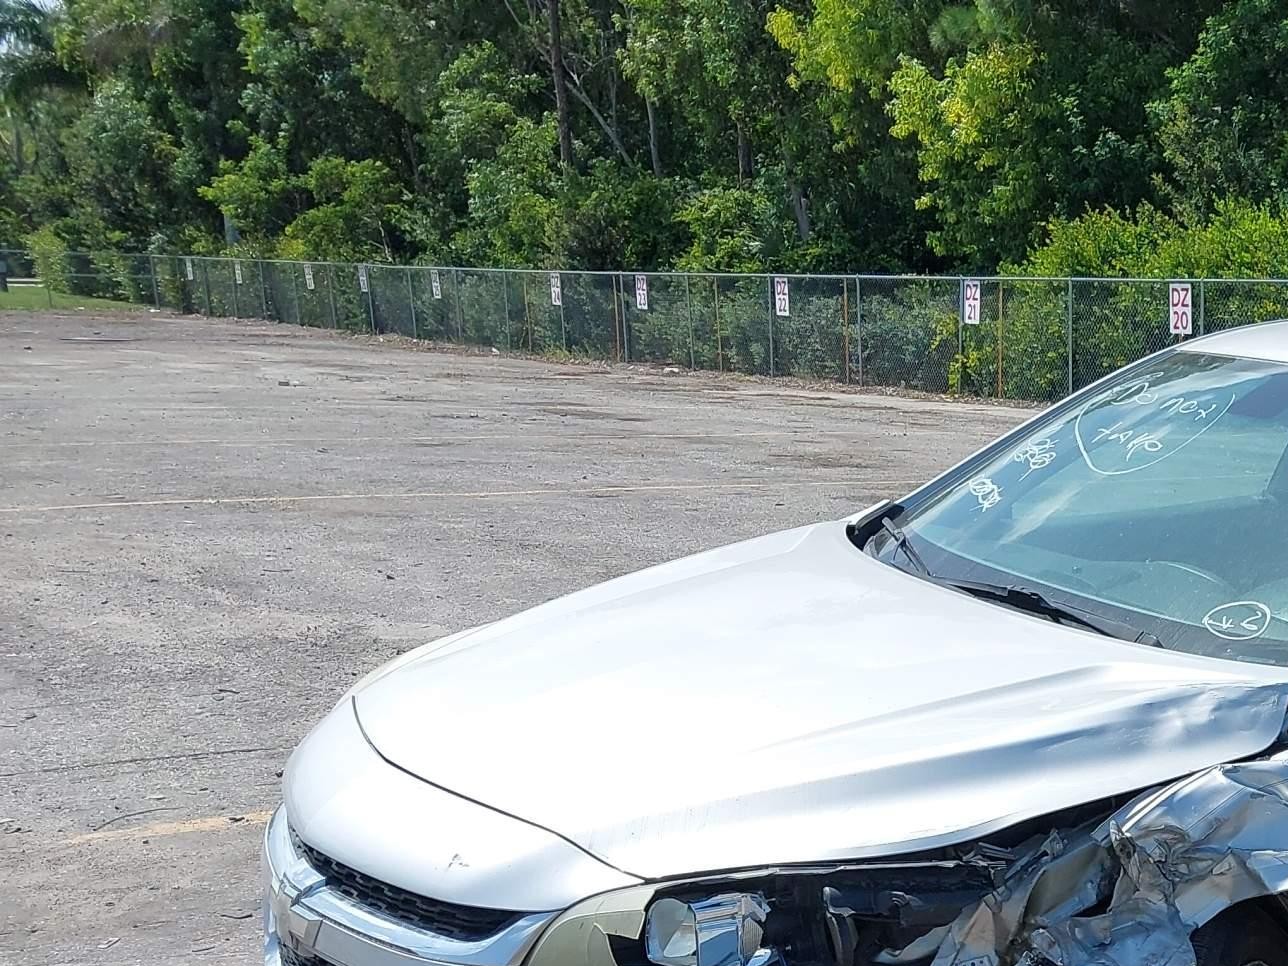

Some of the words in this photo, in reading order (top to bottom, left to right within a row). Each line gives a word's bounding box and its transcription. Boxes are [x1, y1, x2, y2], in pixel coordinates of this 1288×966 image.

[637, 277, 646, 291] DZ
[776, 280, 787, 295] DZ
[638, 292, 647, 306] 23
[966, 284, 979, 301] DZ
[1171, 287, 1189, 307] DZ
[778, 297, 787, 312] 22
[968, 303, 976, 320] 21
[1173, 311, 1188, 330] 20
